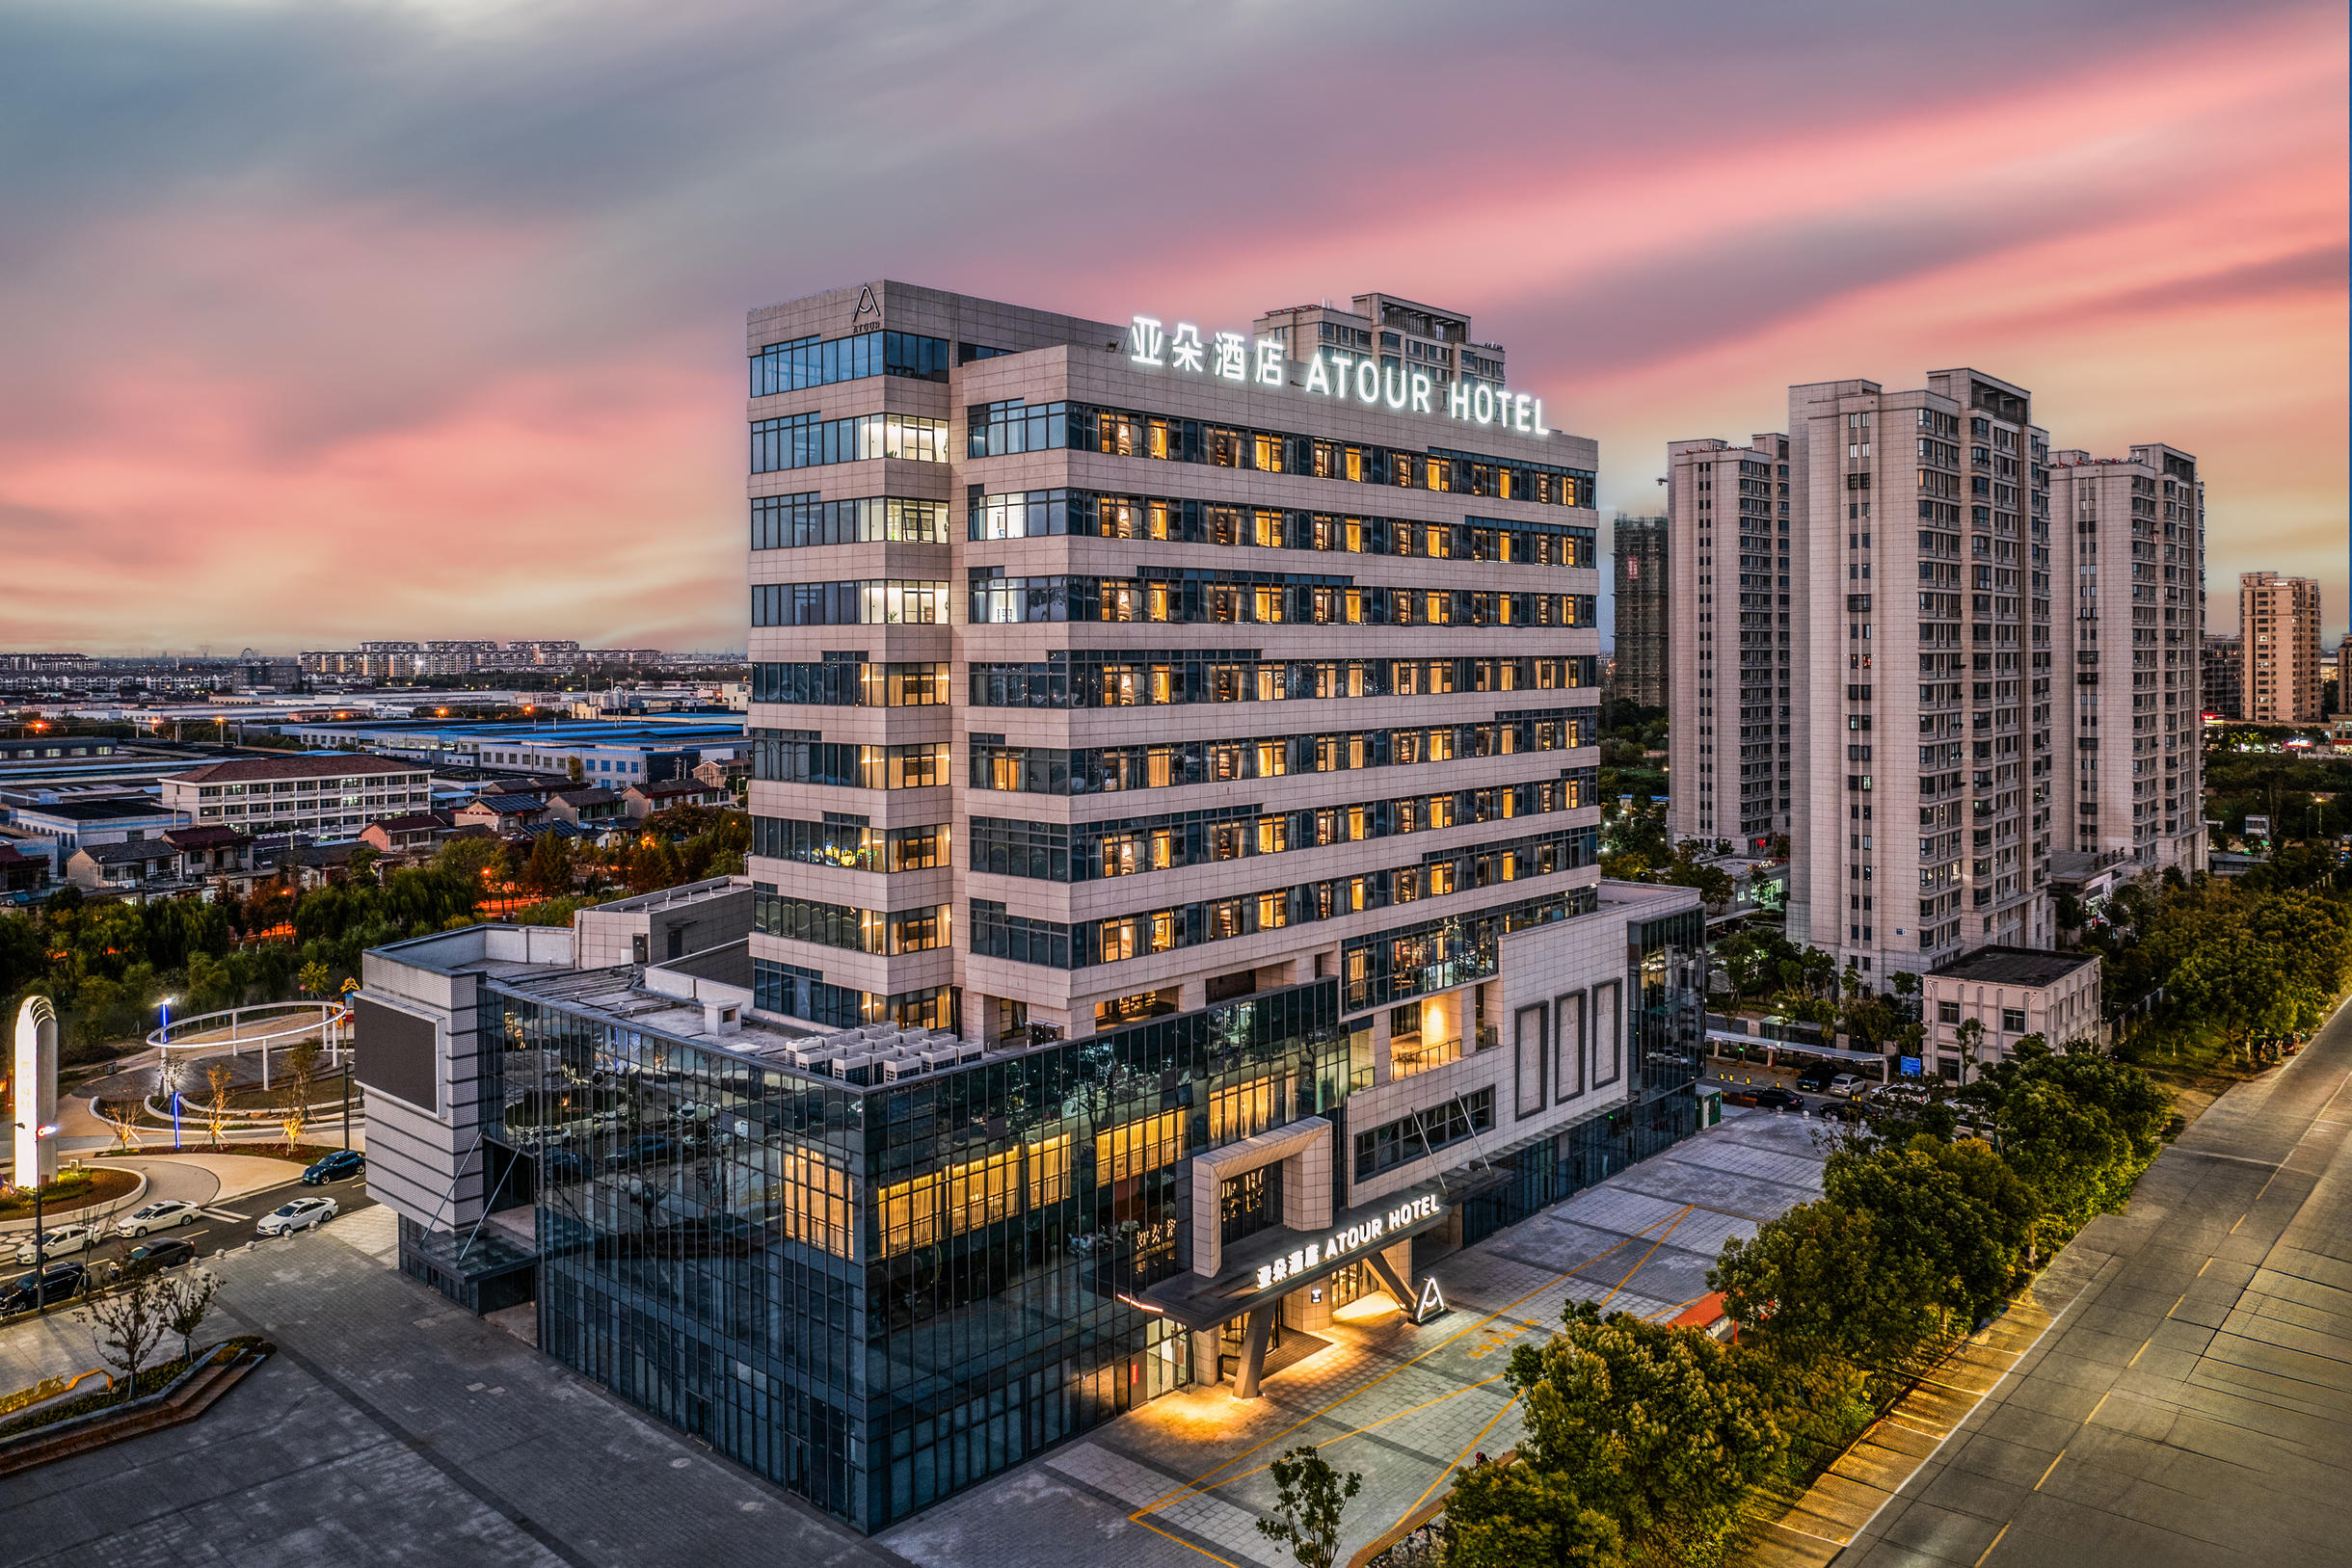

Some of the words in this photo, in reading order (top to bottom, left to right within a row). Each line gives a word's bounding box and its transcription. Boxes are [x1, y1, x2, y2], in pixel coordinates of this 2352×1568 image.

[1131, 315, 1284, 386] 亚朵酒店
[1305, 352, 1431, 414] ATOUR
[1451, 381, 1551, 437] HOTEL
[1324, 1218, 1382, 1260] ATOUR
[1388, 1194, 1440, 1231] HOTEL
[1257, 1243, 1320, 1289] 亚朵酒店
